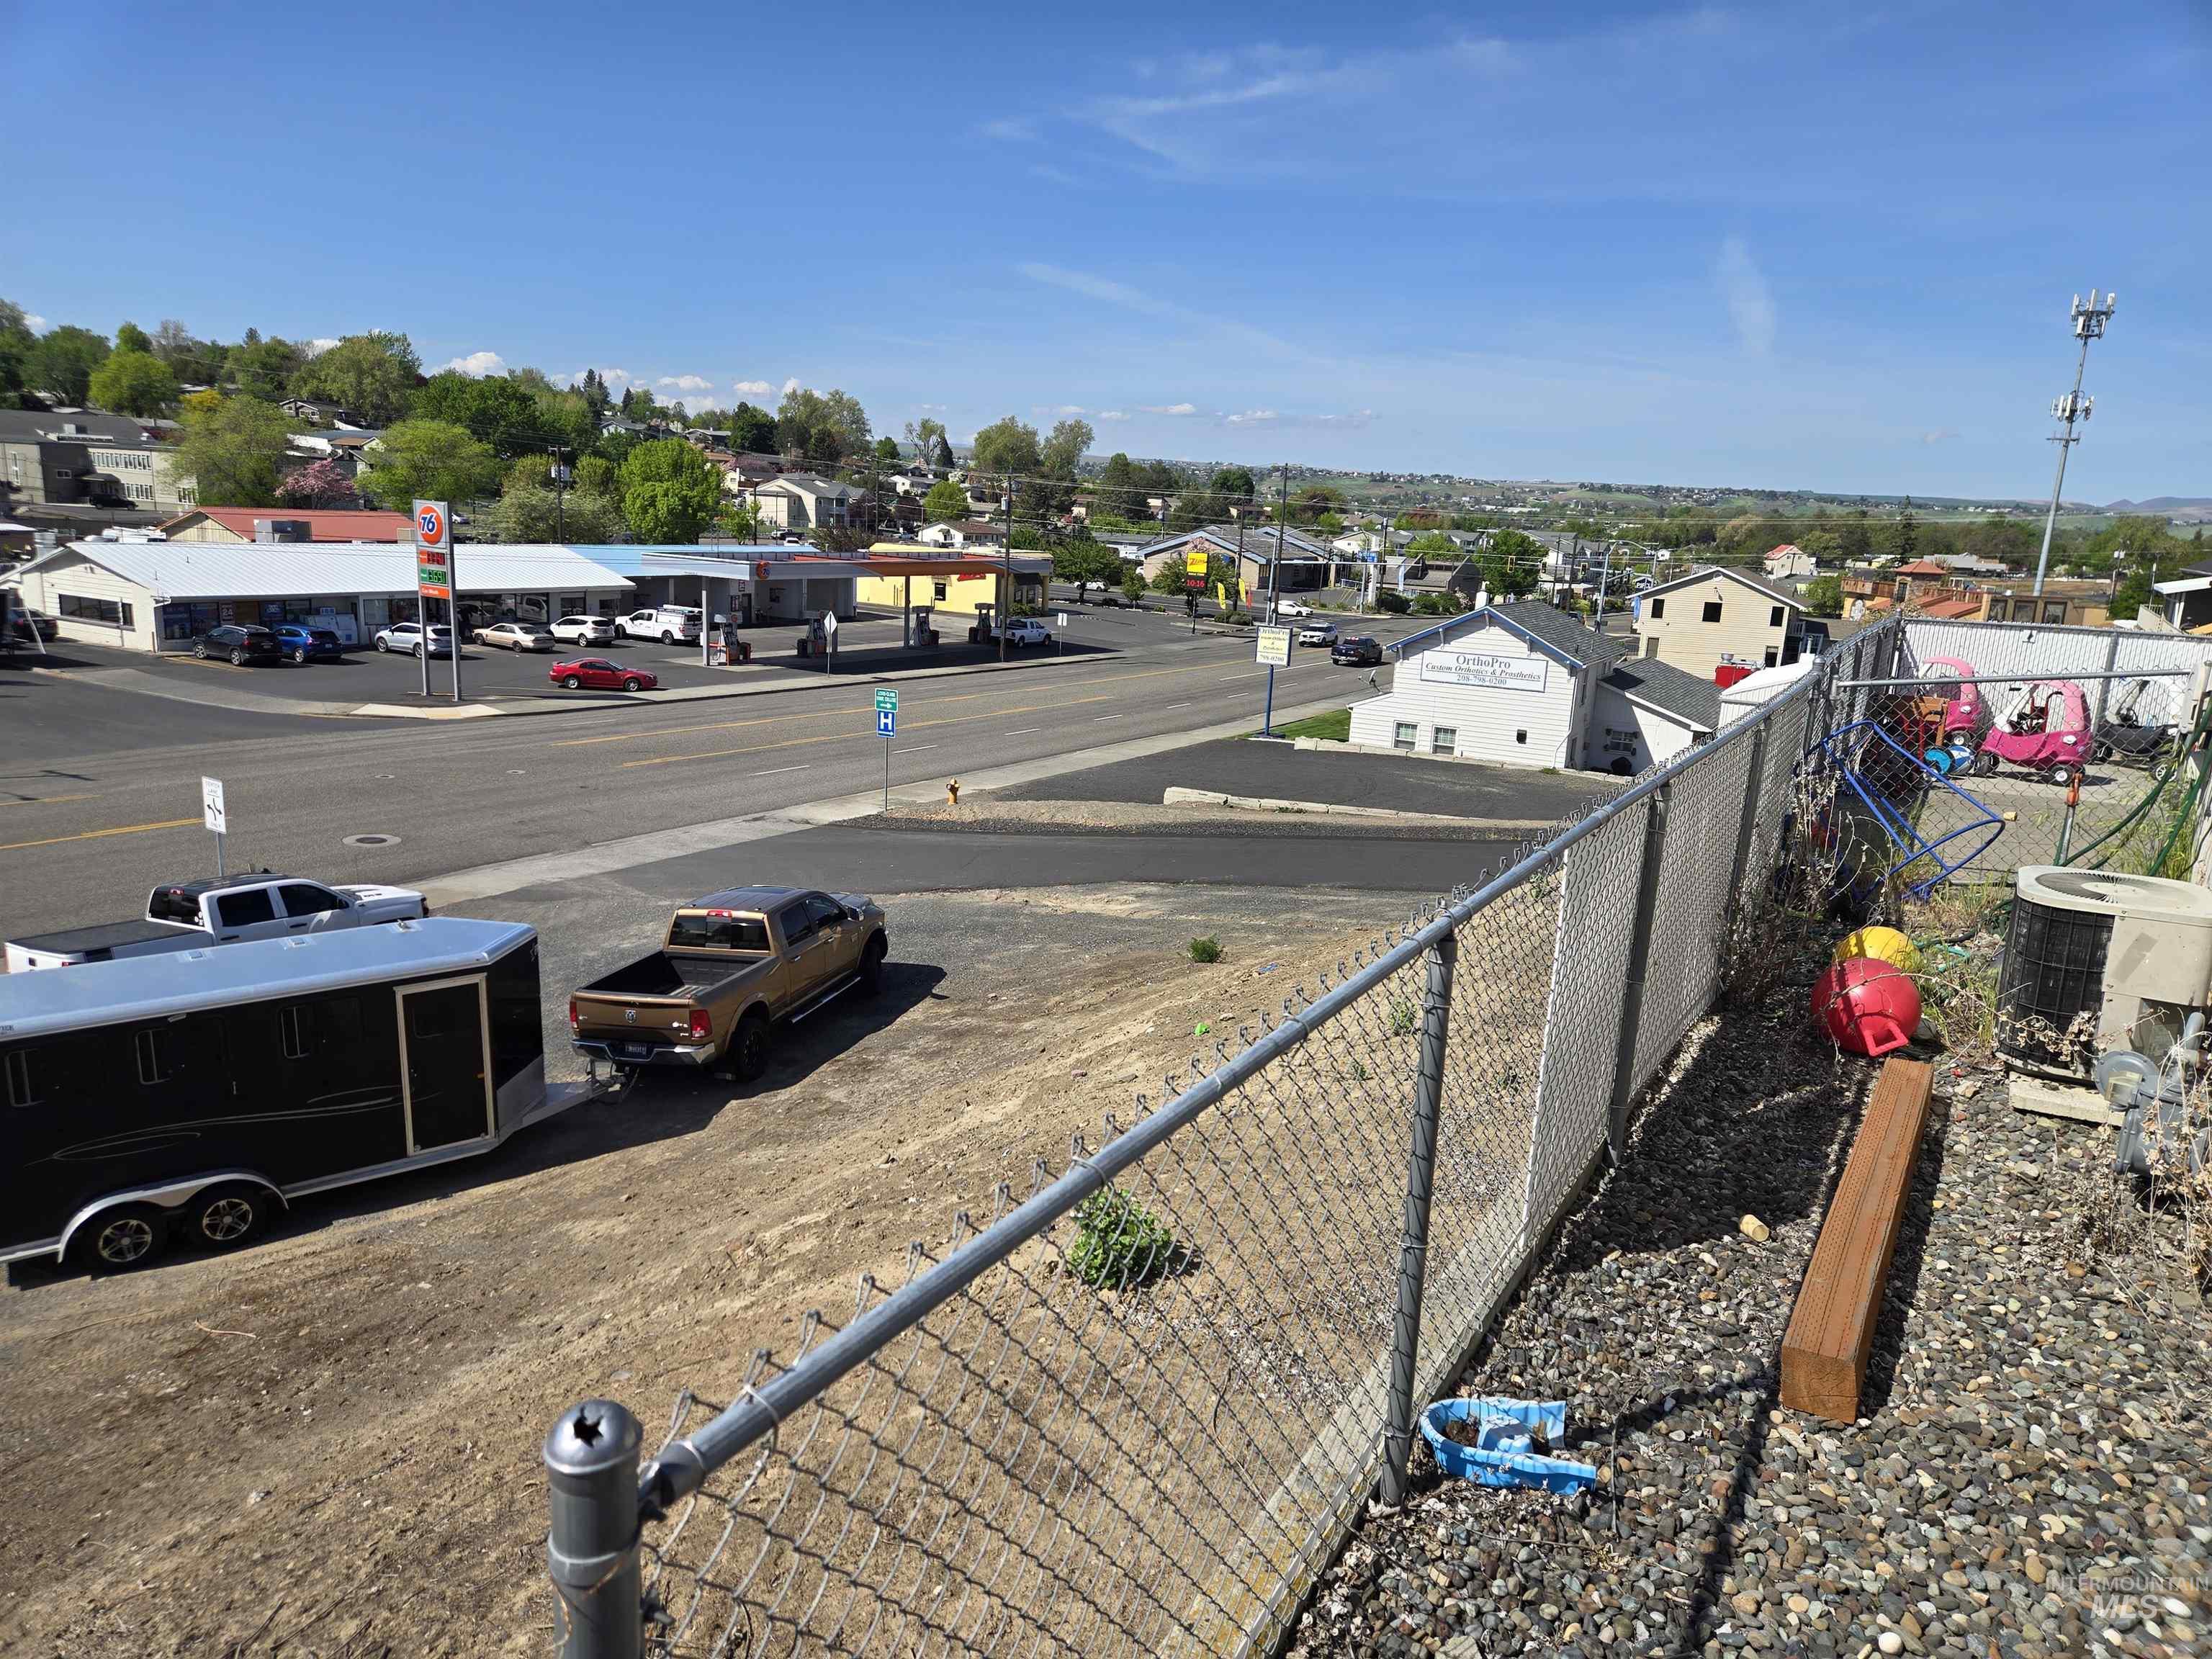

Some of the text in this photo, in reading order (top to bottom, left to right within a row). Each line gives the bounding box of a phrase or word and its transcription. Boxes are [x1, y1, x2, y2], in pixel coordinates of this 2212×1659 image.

[420, 513, 437, 534] 76
[1426, 662, 1453, 672] Custom
[1455, 665, 1488, 675] Orthotics
[1499, 669, 1542, 680] Prosthetics
[1456, 654, 1511, 670] OrthoPro
[1457, 674, 1507, 686] 208-798-0200
[880, 711, 893, 731] H
